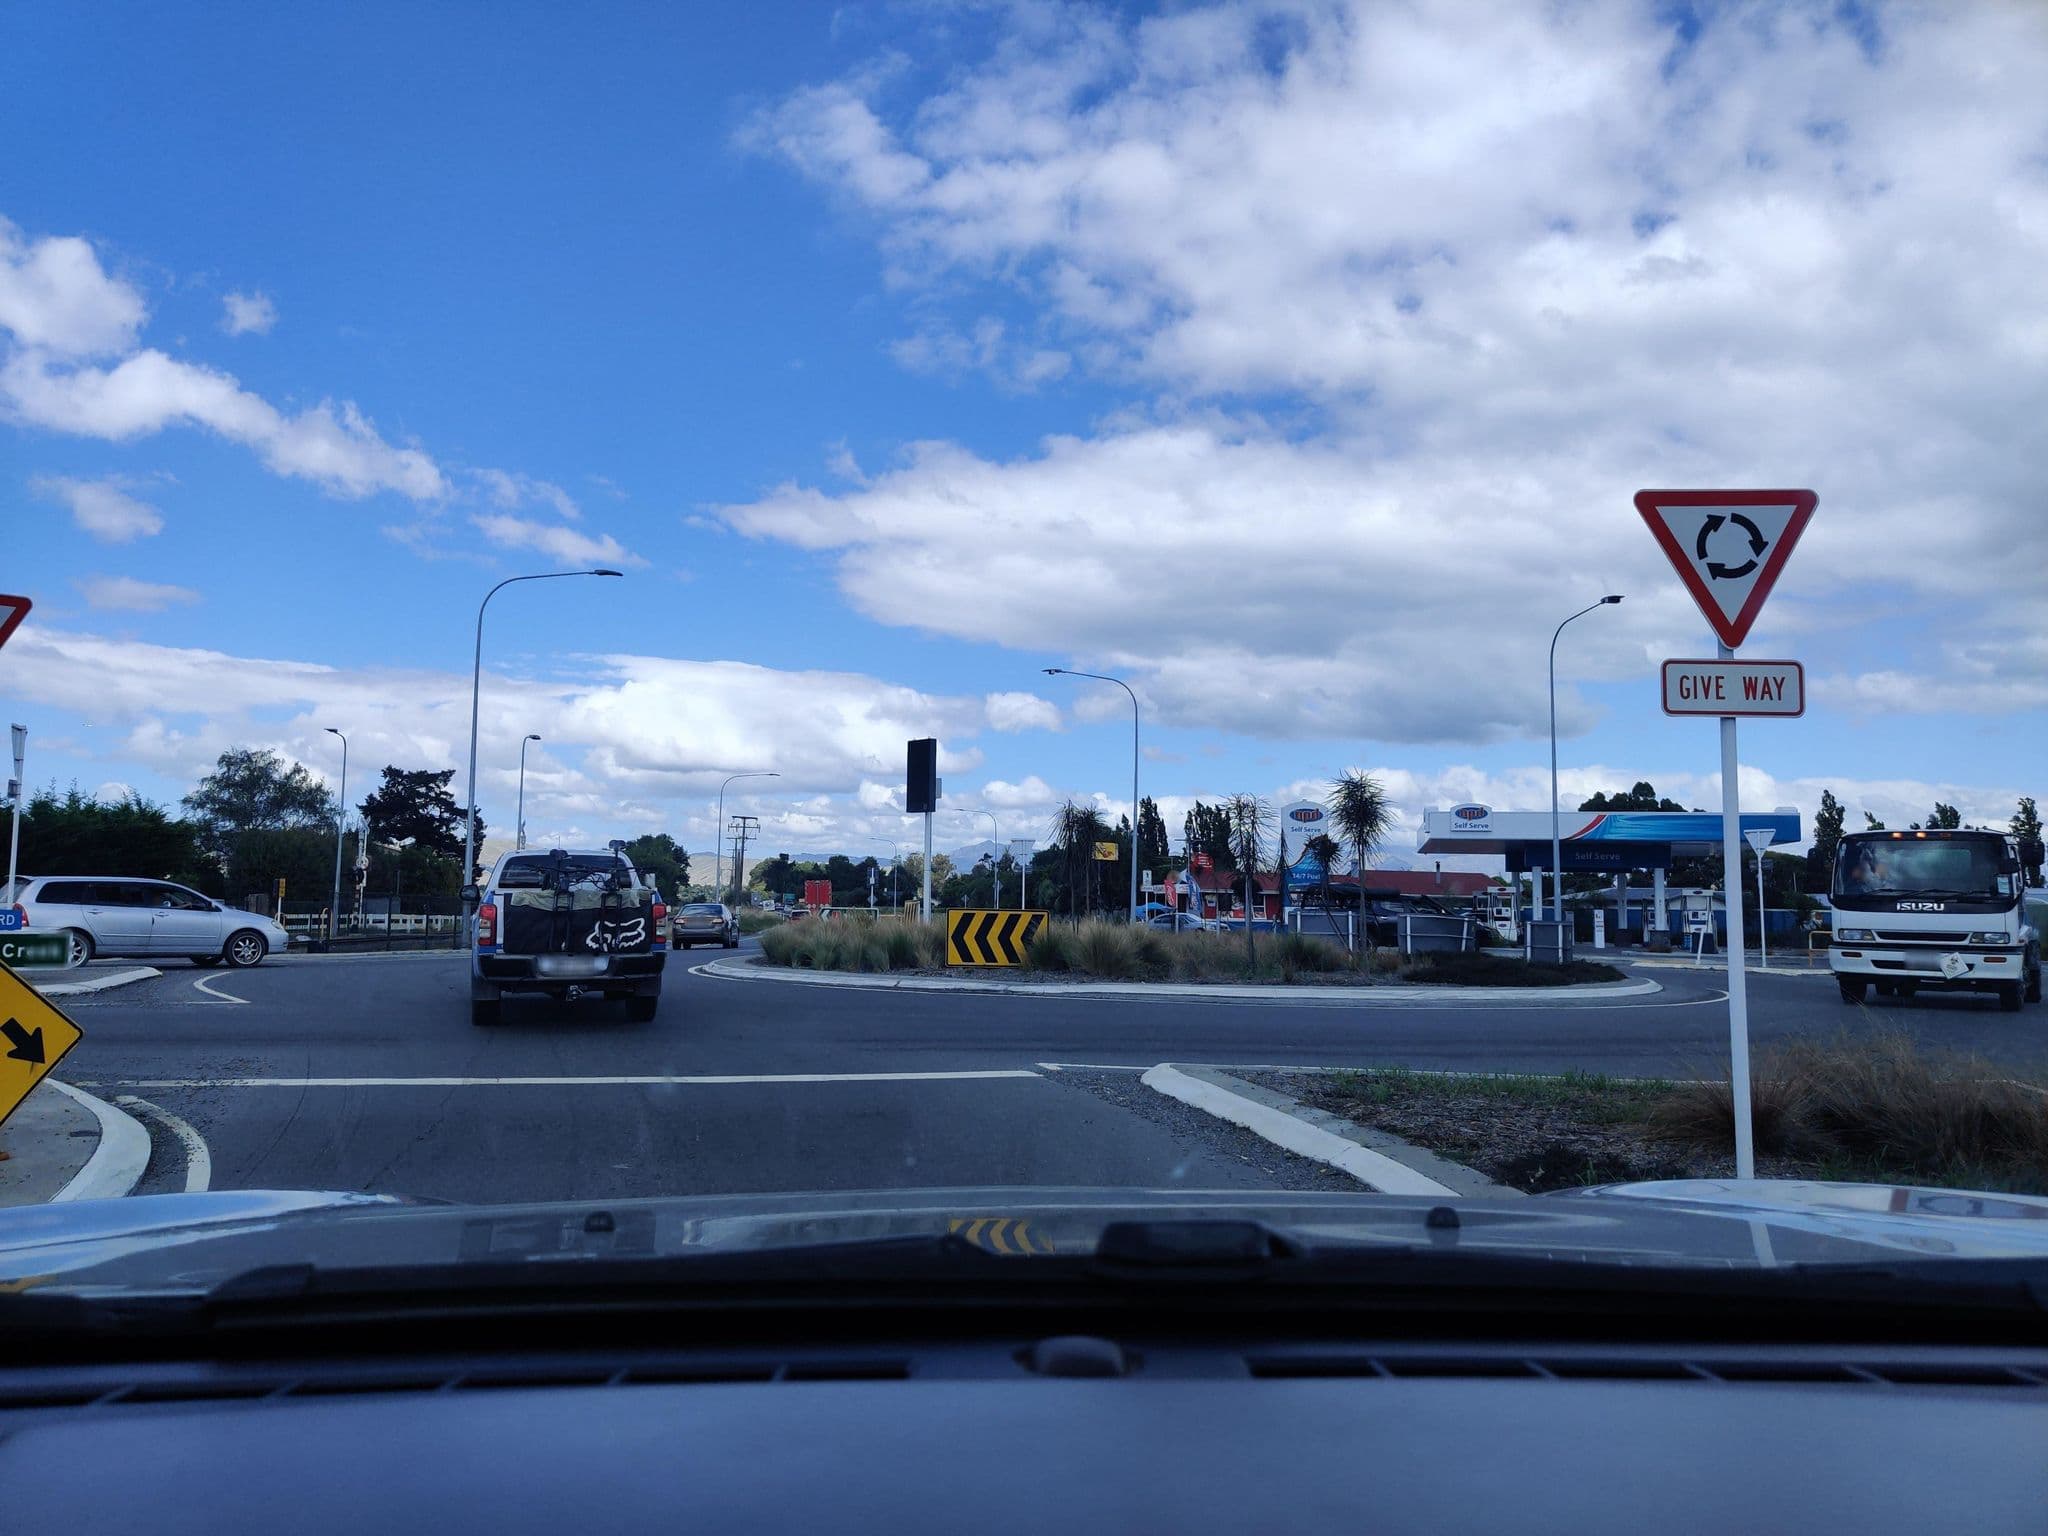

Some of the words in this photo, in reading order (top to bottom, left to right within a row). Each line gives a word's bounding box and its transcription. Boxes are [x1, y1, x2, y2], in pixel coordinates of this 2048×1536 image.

[1679, 675, 1726, 700] GIVE
[1742, 676, 1786, 701] WAY
[1469, 822, 1489, 830] Serve
[1575, 851, 1591, 860] Self
[1594, 851, 1621, 860] Serve
[1896, 902, 1944, 911] ISUZU
